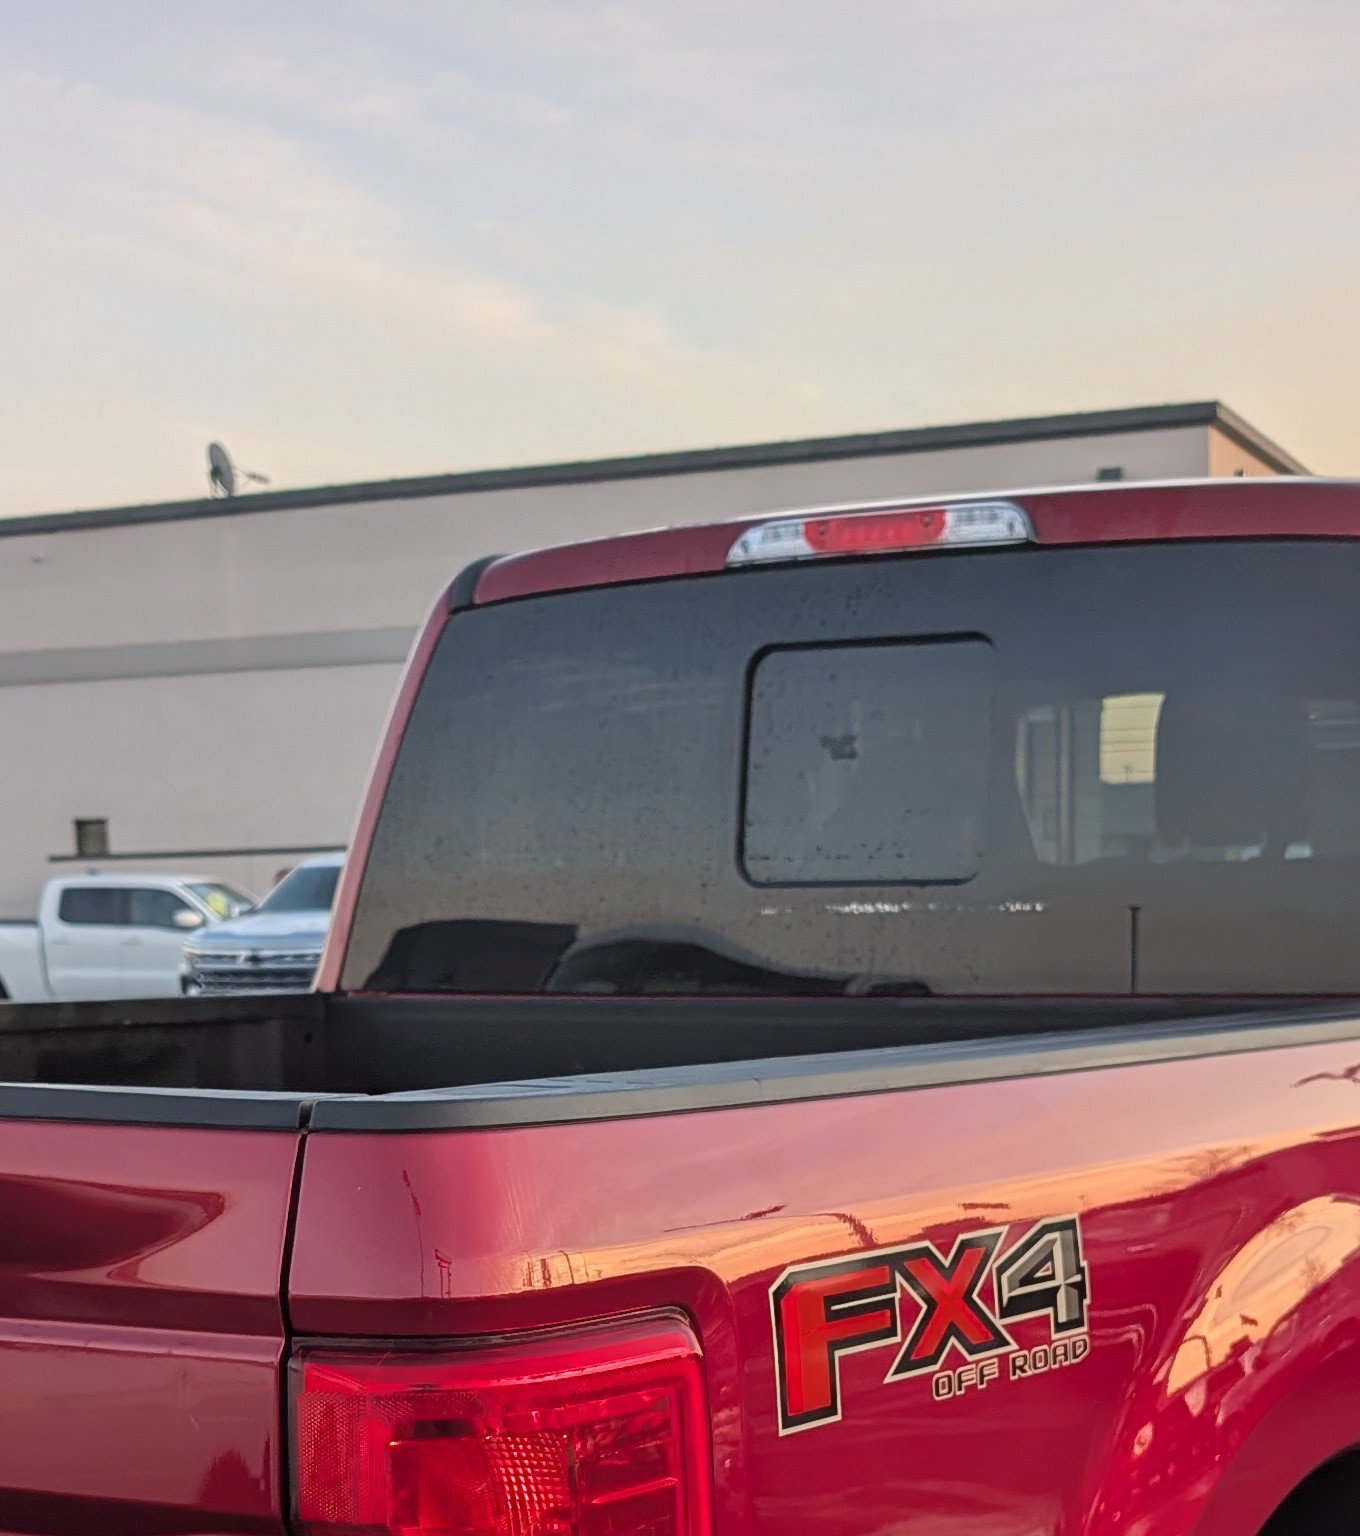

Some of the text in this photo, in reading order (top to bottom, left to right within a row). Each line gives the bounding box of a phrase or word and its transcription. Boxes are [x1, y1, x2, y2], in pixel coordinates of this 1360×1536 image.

[768, 1213, 1091, 1437] FX4
[933, 1335, 1089, 1401] OFF ROAD
